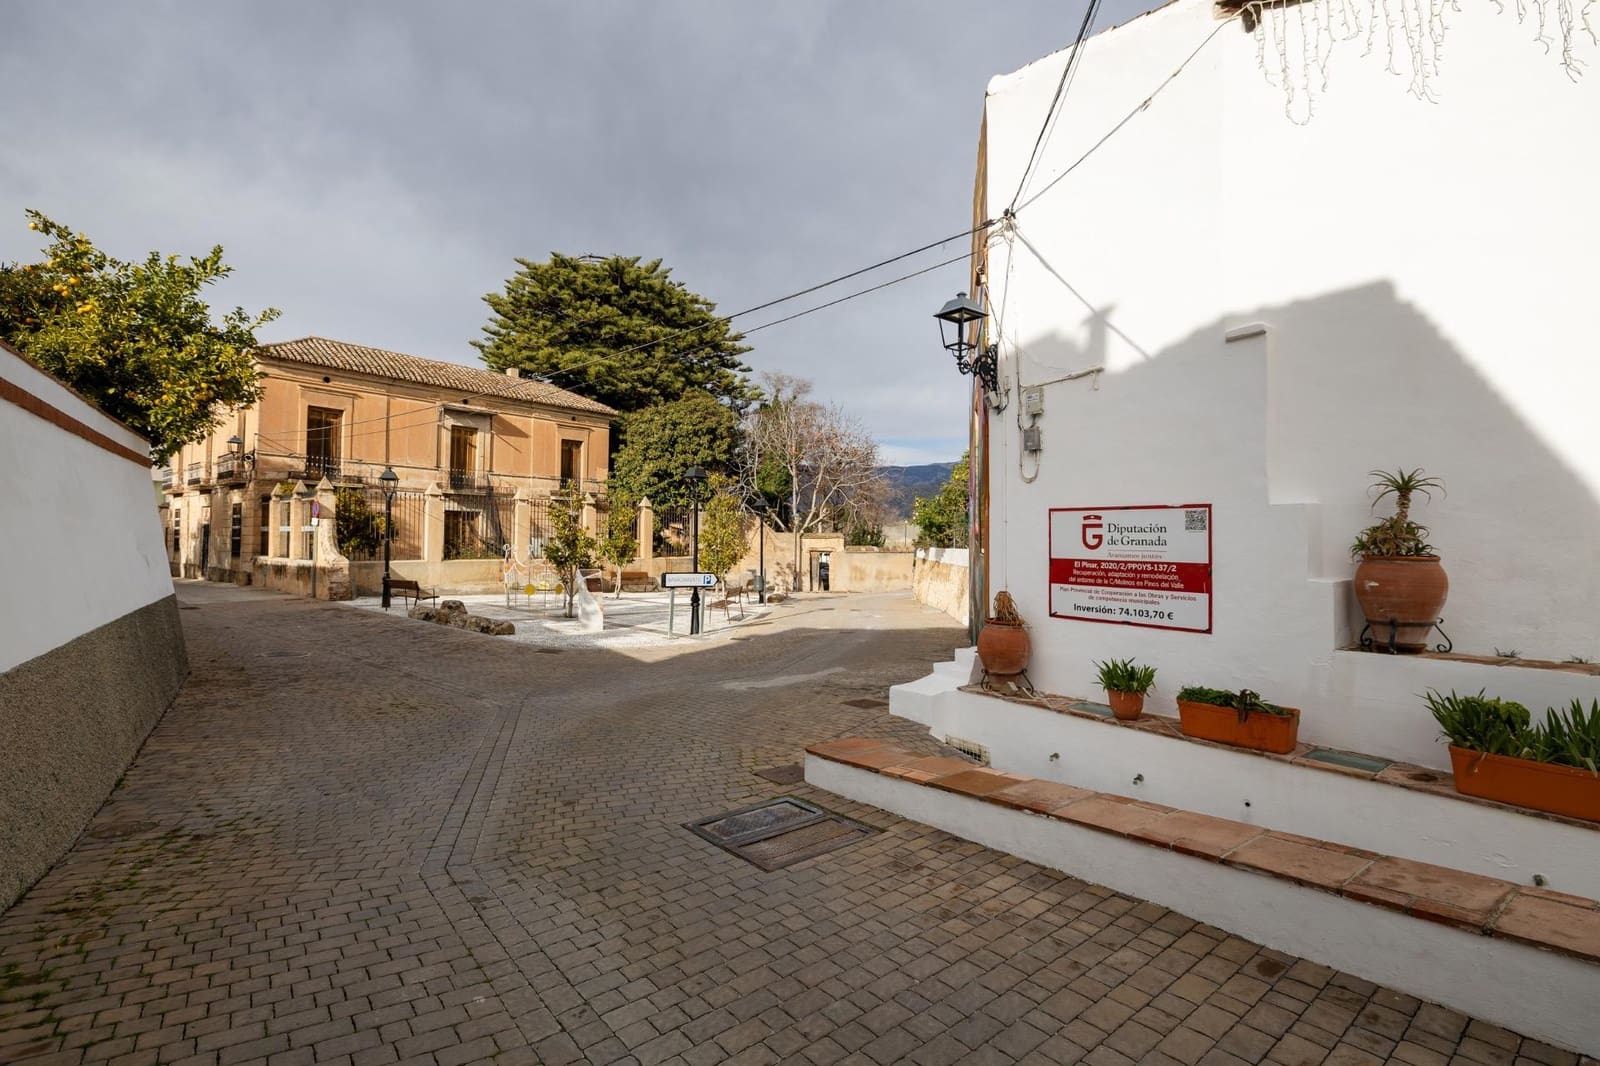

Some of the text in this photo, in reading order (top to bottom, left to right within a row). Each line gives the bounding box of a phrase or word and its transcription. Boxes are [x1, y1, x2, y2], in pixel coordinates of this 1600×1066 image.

[1108, 523, 1167, 535] Diputación
[1107, 536, 1167, 546] de Granada
[1073, 603, 1174, 620] Inversión: 74.103,70 €
